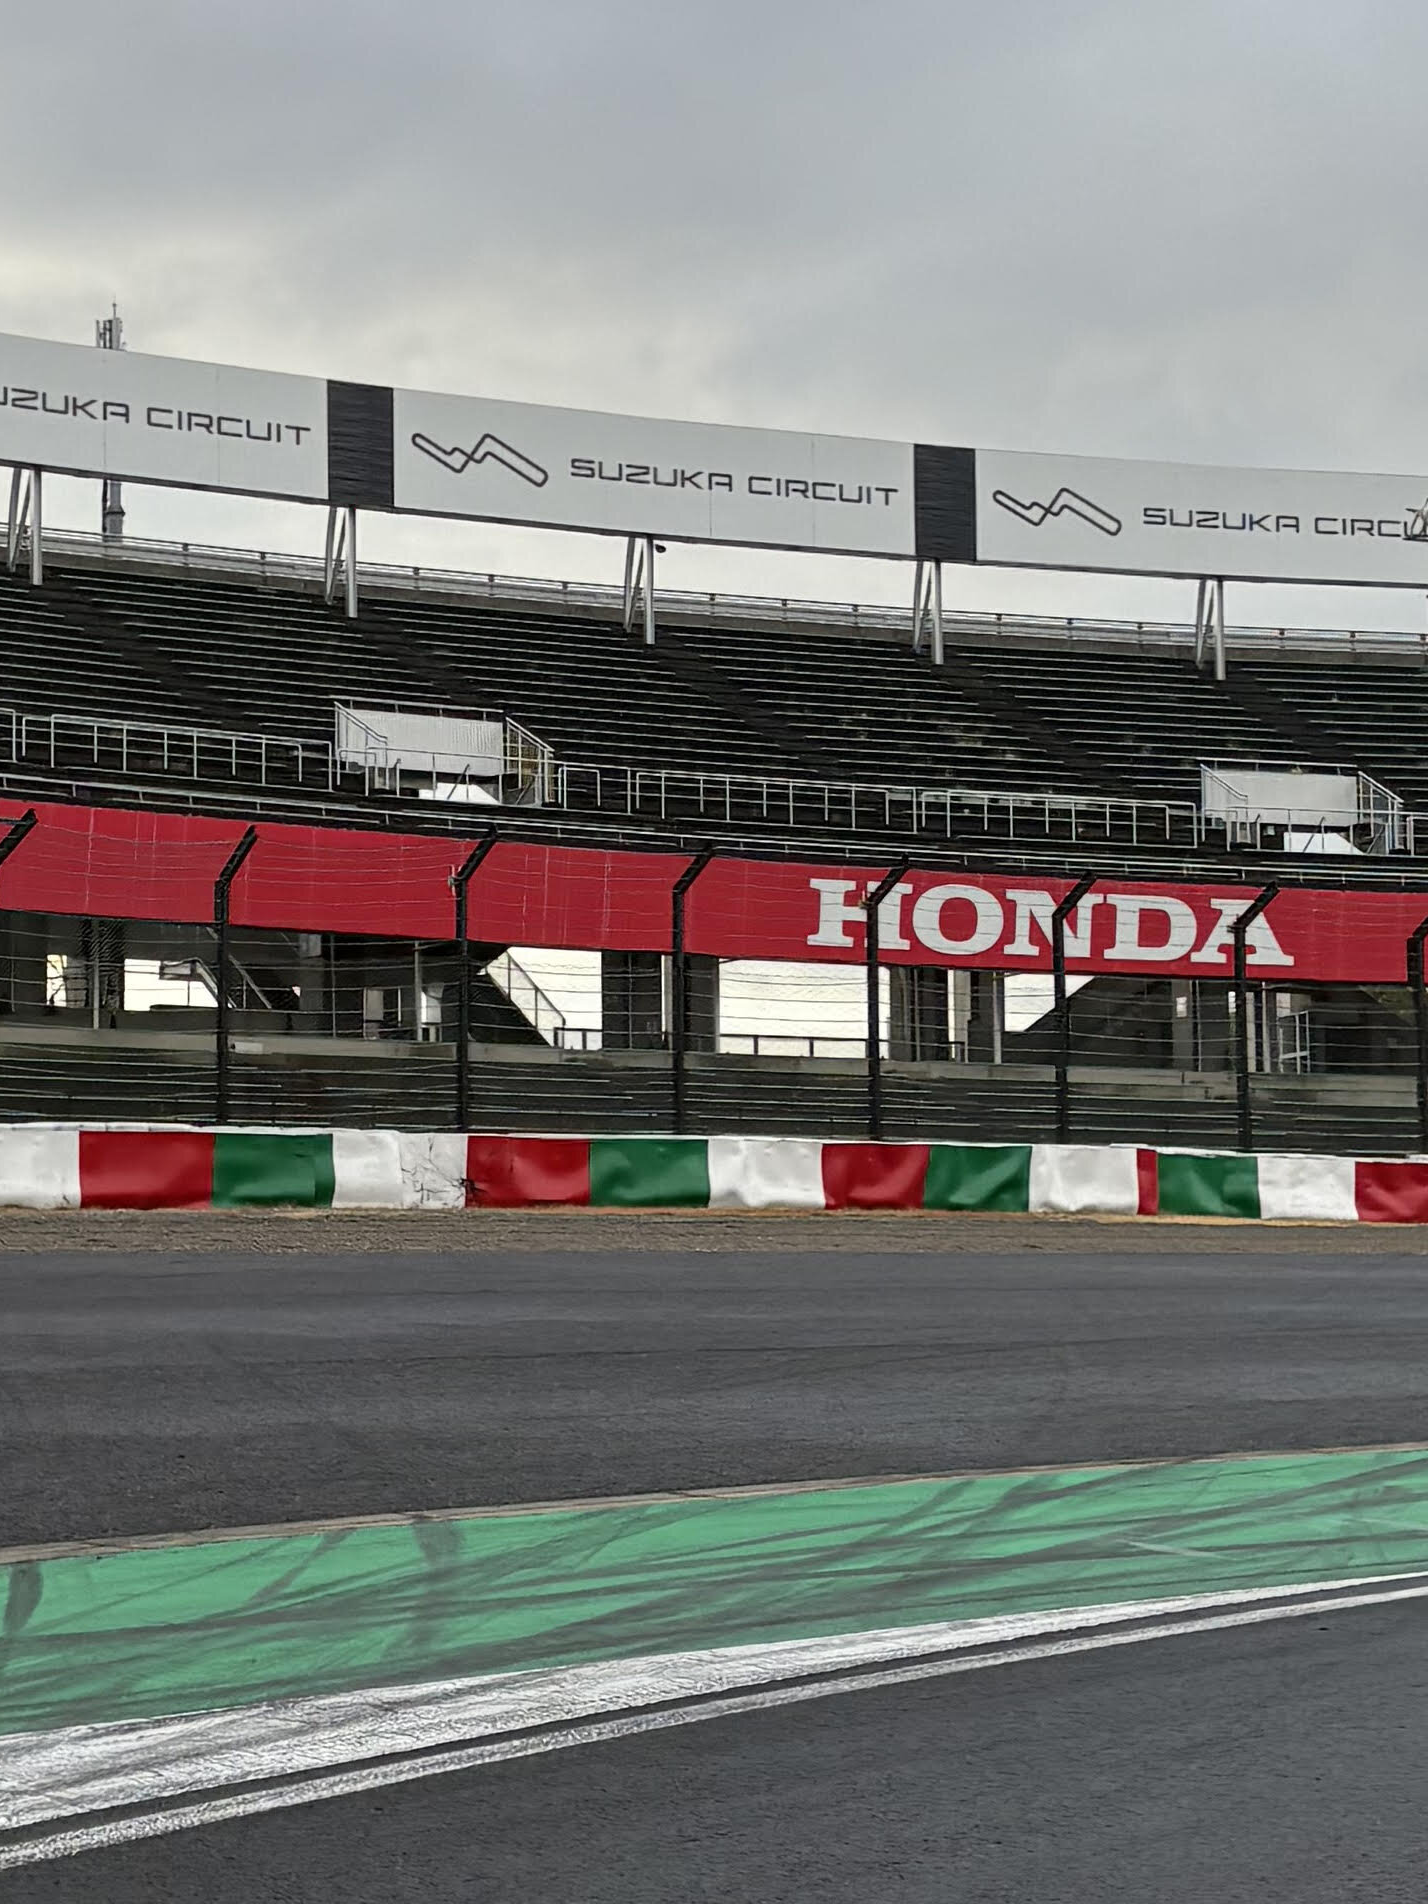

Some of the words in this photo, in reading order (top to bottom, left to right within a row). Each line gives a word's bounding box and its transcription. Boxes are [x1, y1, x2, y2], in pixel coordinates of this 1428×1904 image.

[146, 407, 312, 446] CIRCUIT
[570, 458, 733, 492] SUZUKA
[747, 476, 899, 506] CIRCUIT
[1142, 507, 1300, 533] SUZUKA
[806, 878, 1296, 967] HONDA
